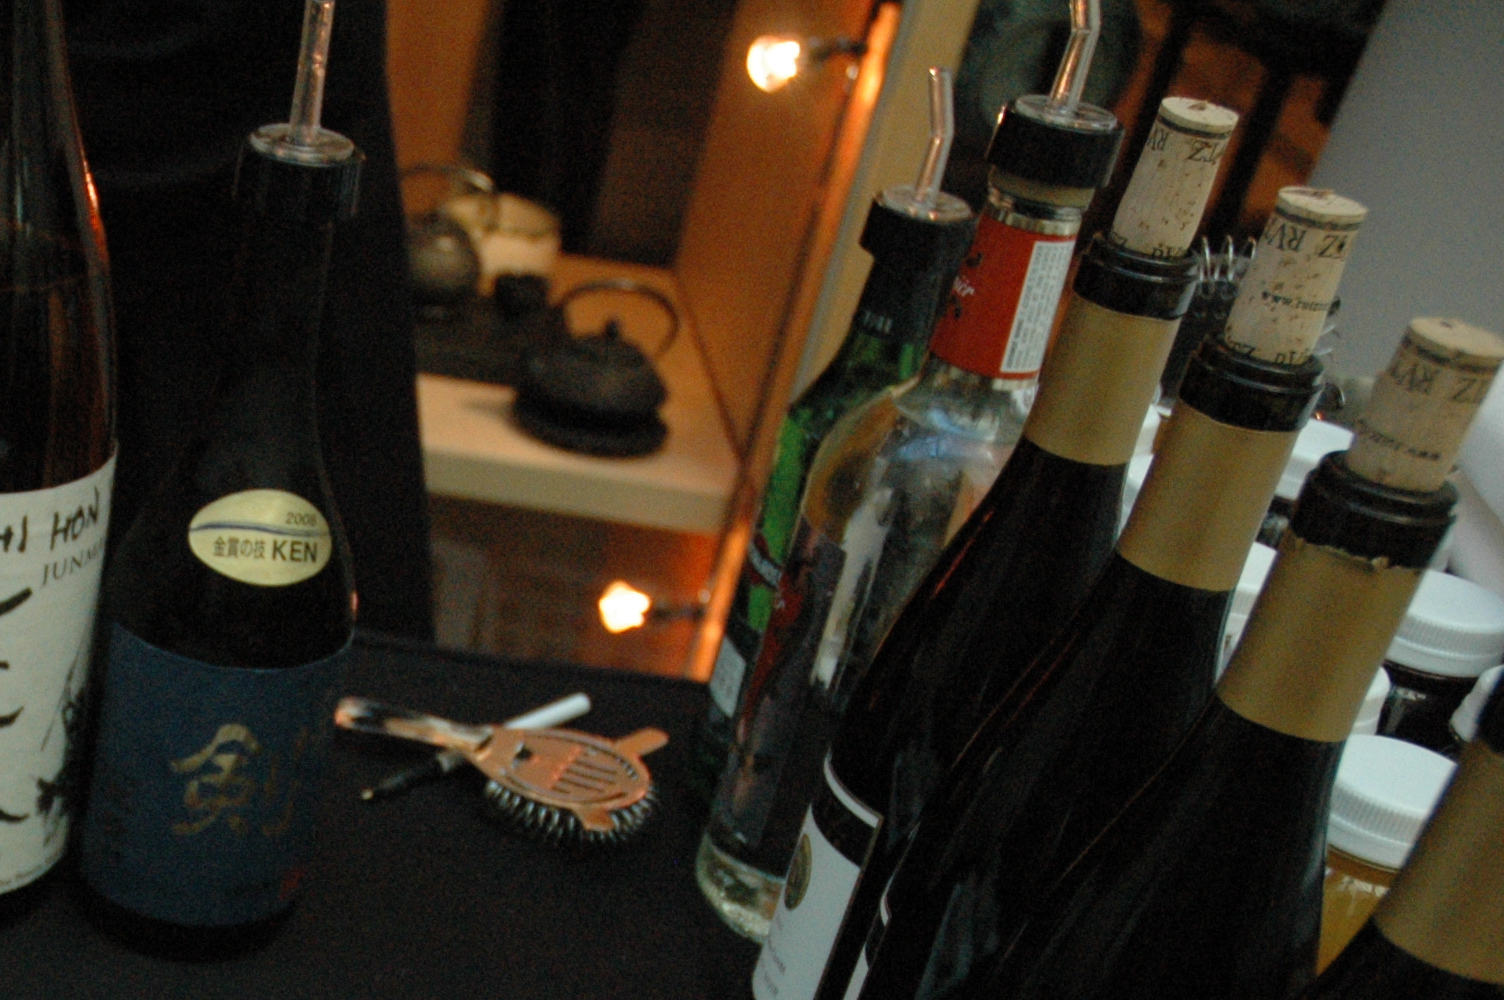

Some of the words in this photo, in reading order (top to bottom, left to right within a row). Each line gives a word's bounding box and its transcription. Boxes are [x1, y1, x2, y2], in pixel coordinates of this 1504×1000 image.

[1186, 139, 1224, 166] TZ
[50, 486, 99, 551] HON
[271, 539, 318, 563] KEN
